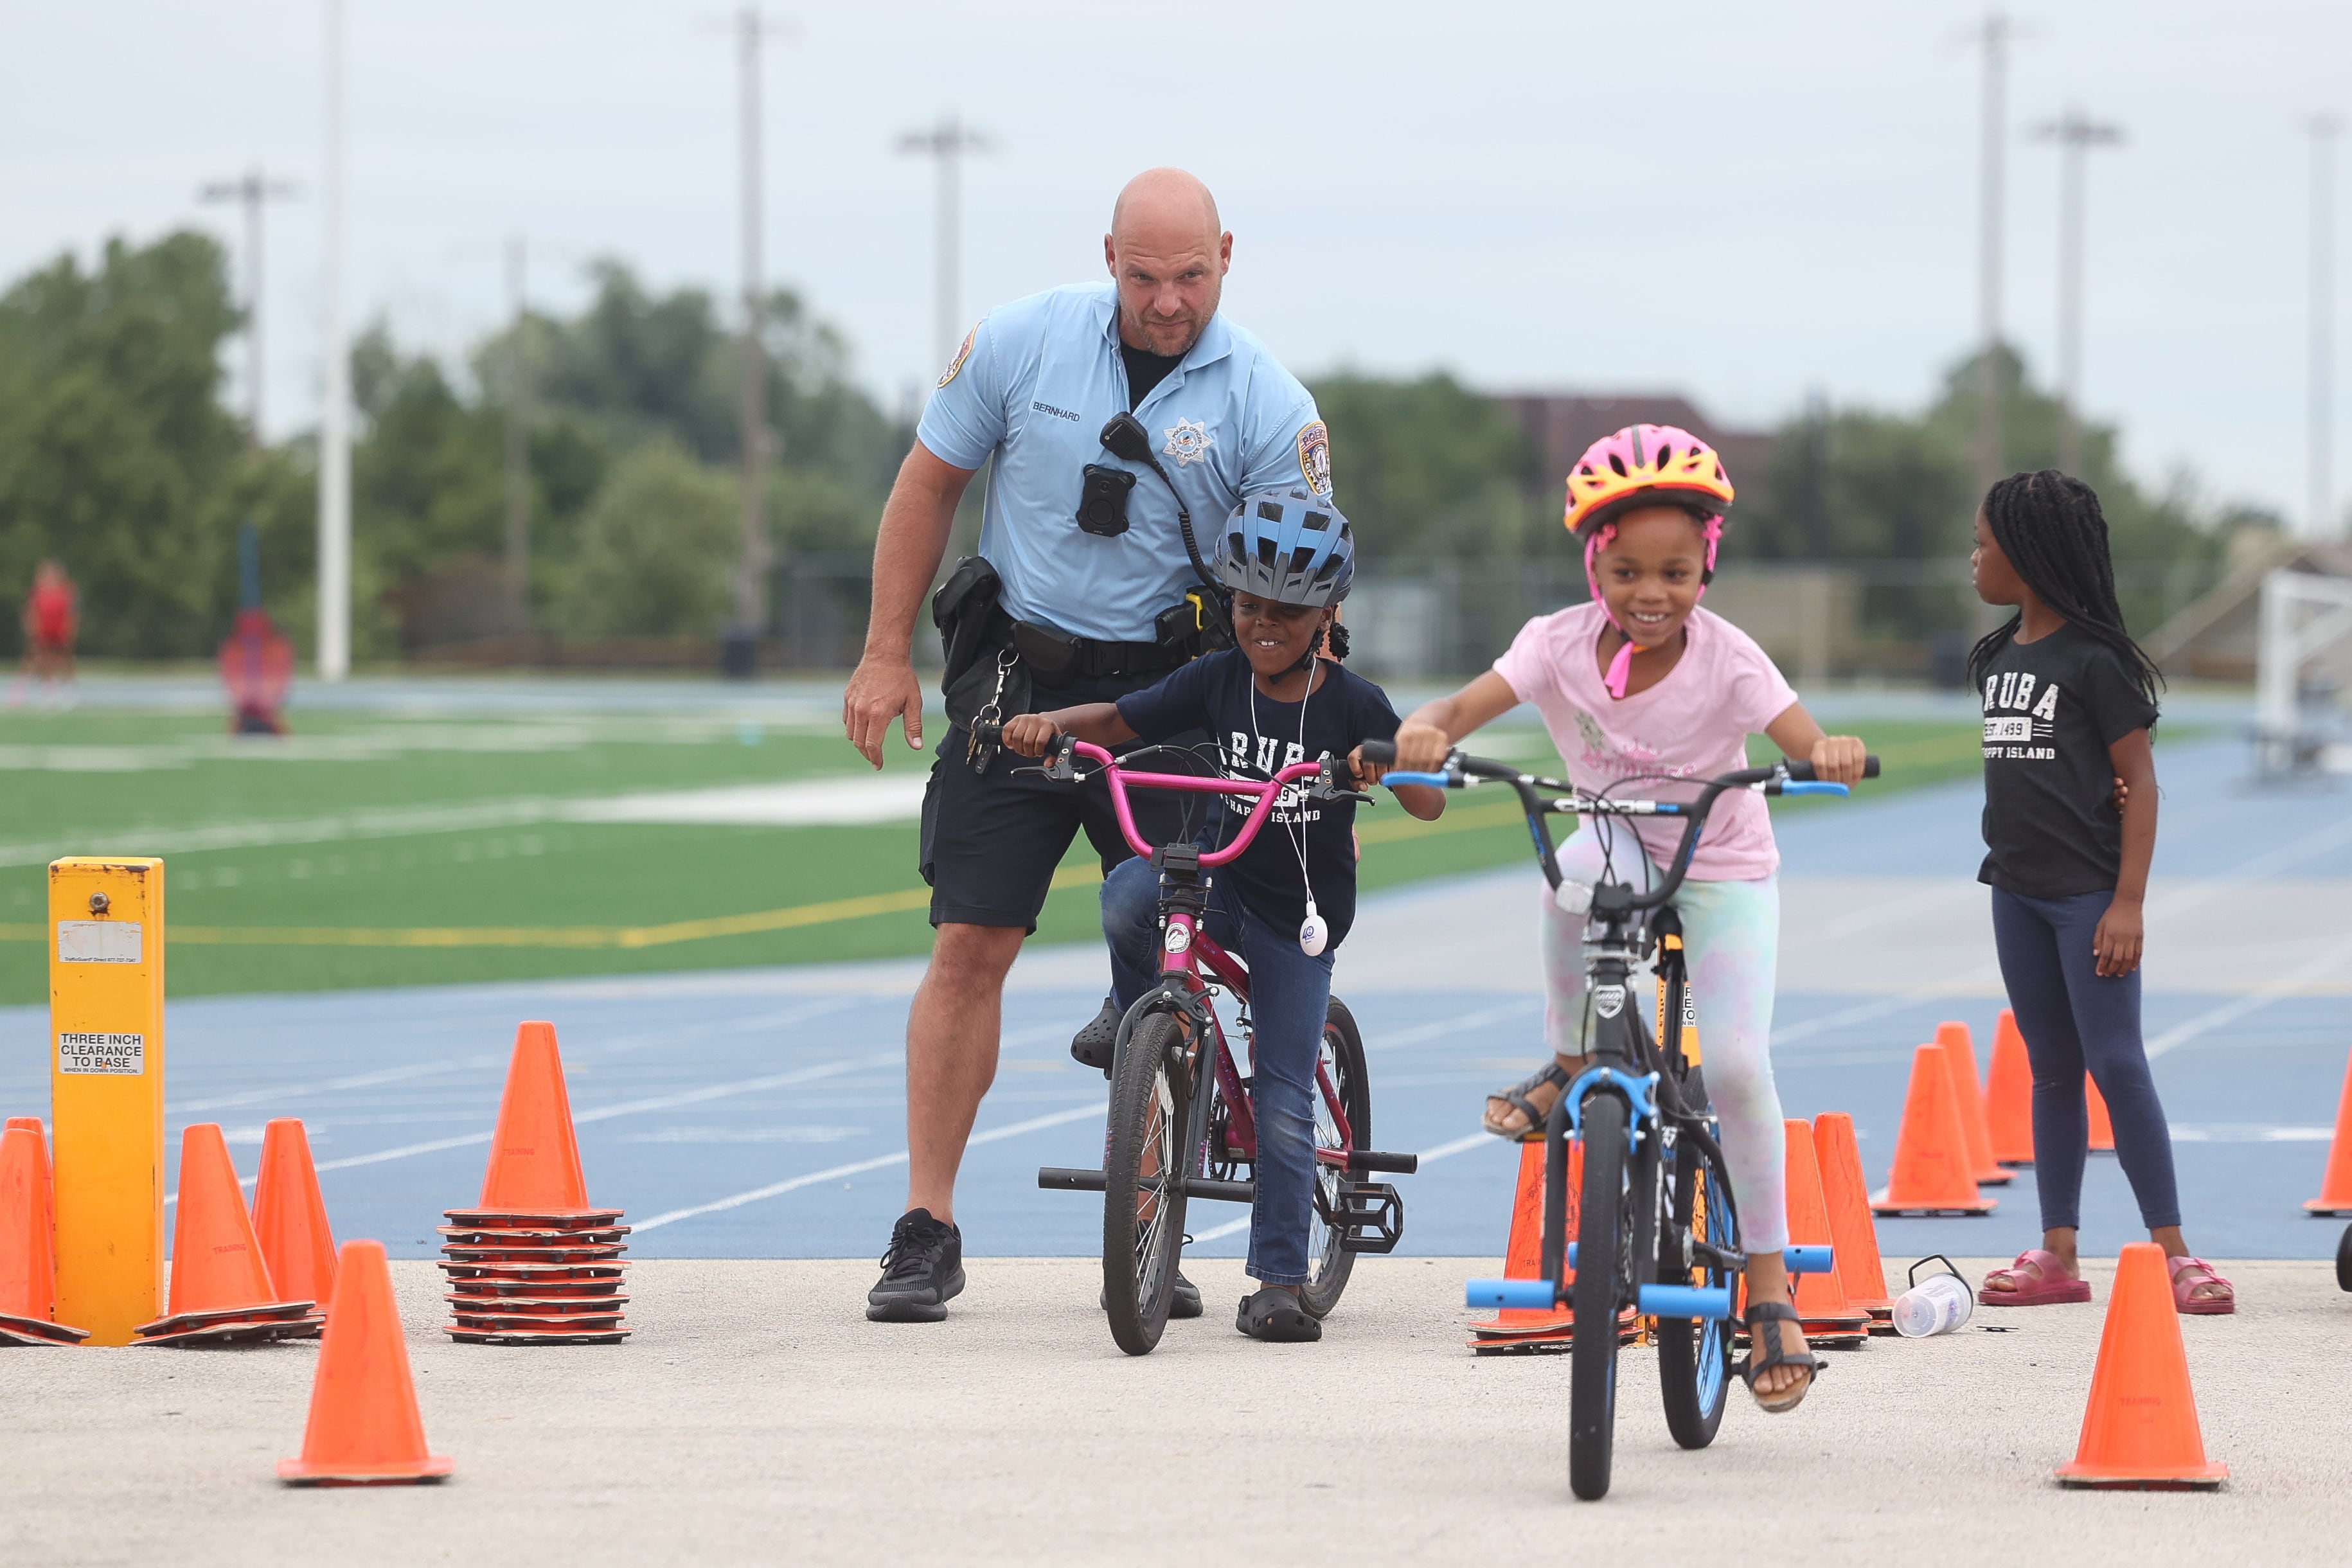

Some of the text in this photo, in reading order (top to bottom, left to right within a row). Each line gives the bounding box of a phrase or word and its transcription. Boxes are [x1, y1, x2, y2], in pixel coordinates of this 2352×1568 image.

[1033, 402, 1080, 422] BERNHARD
[1217, 731, 1331, 783] RUB
[2006, 747, 2055, 760] ISLAND
[1230, 799, 1254, 815] HAP
[1271, 810, 1321, 823] ISLAND
[61, 1033, 141, 1045] THREE INCH
[61, 1045, 141, 1056] CLEARANCE
[72, 1056, 130, 1067] TO BASE
